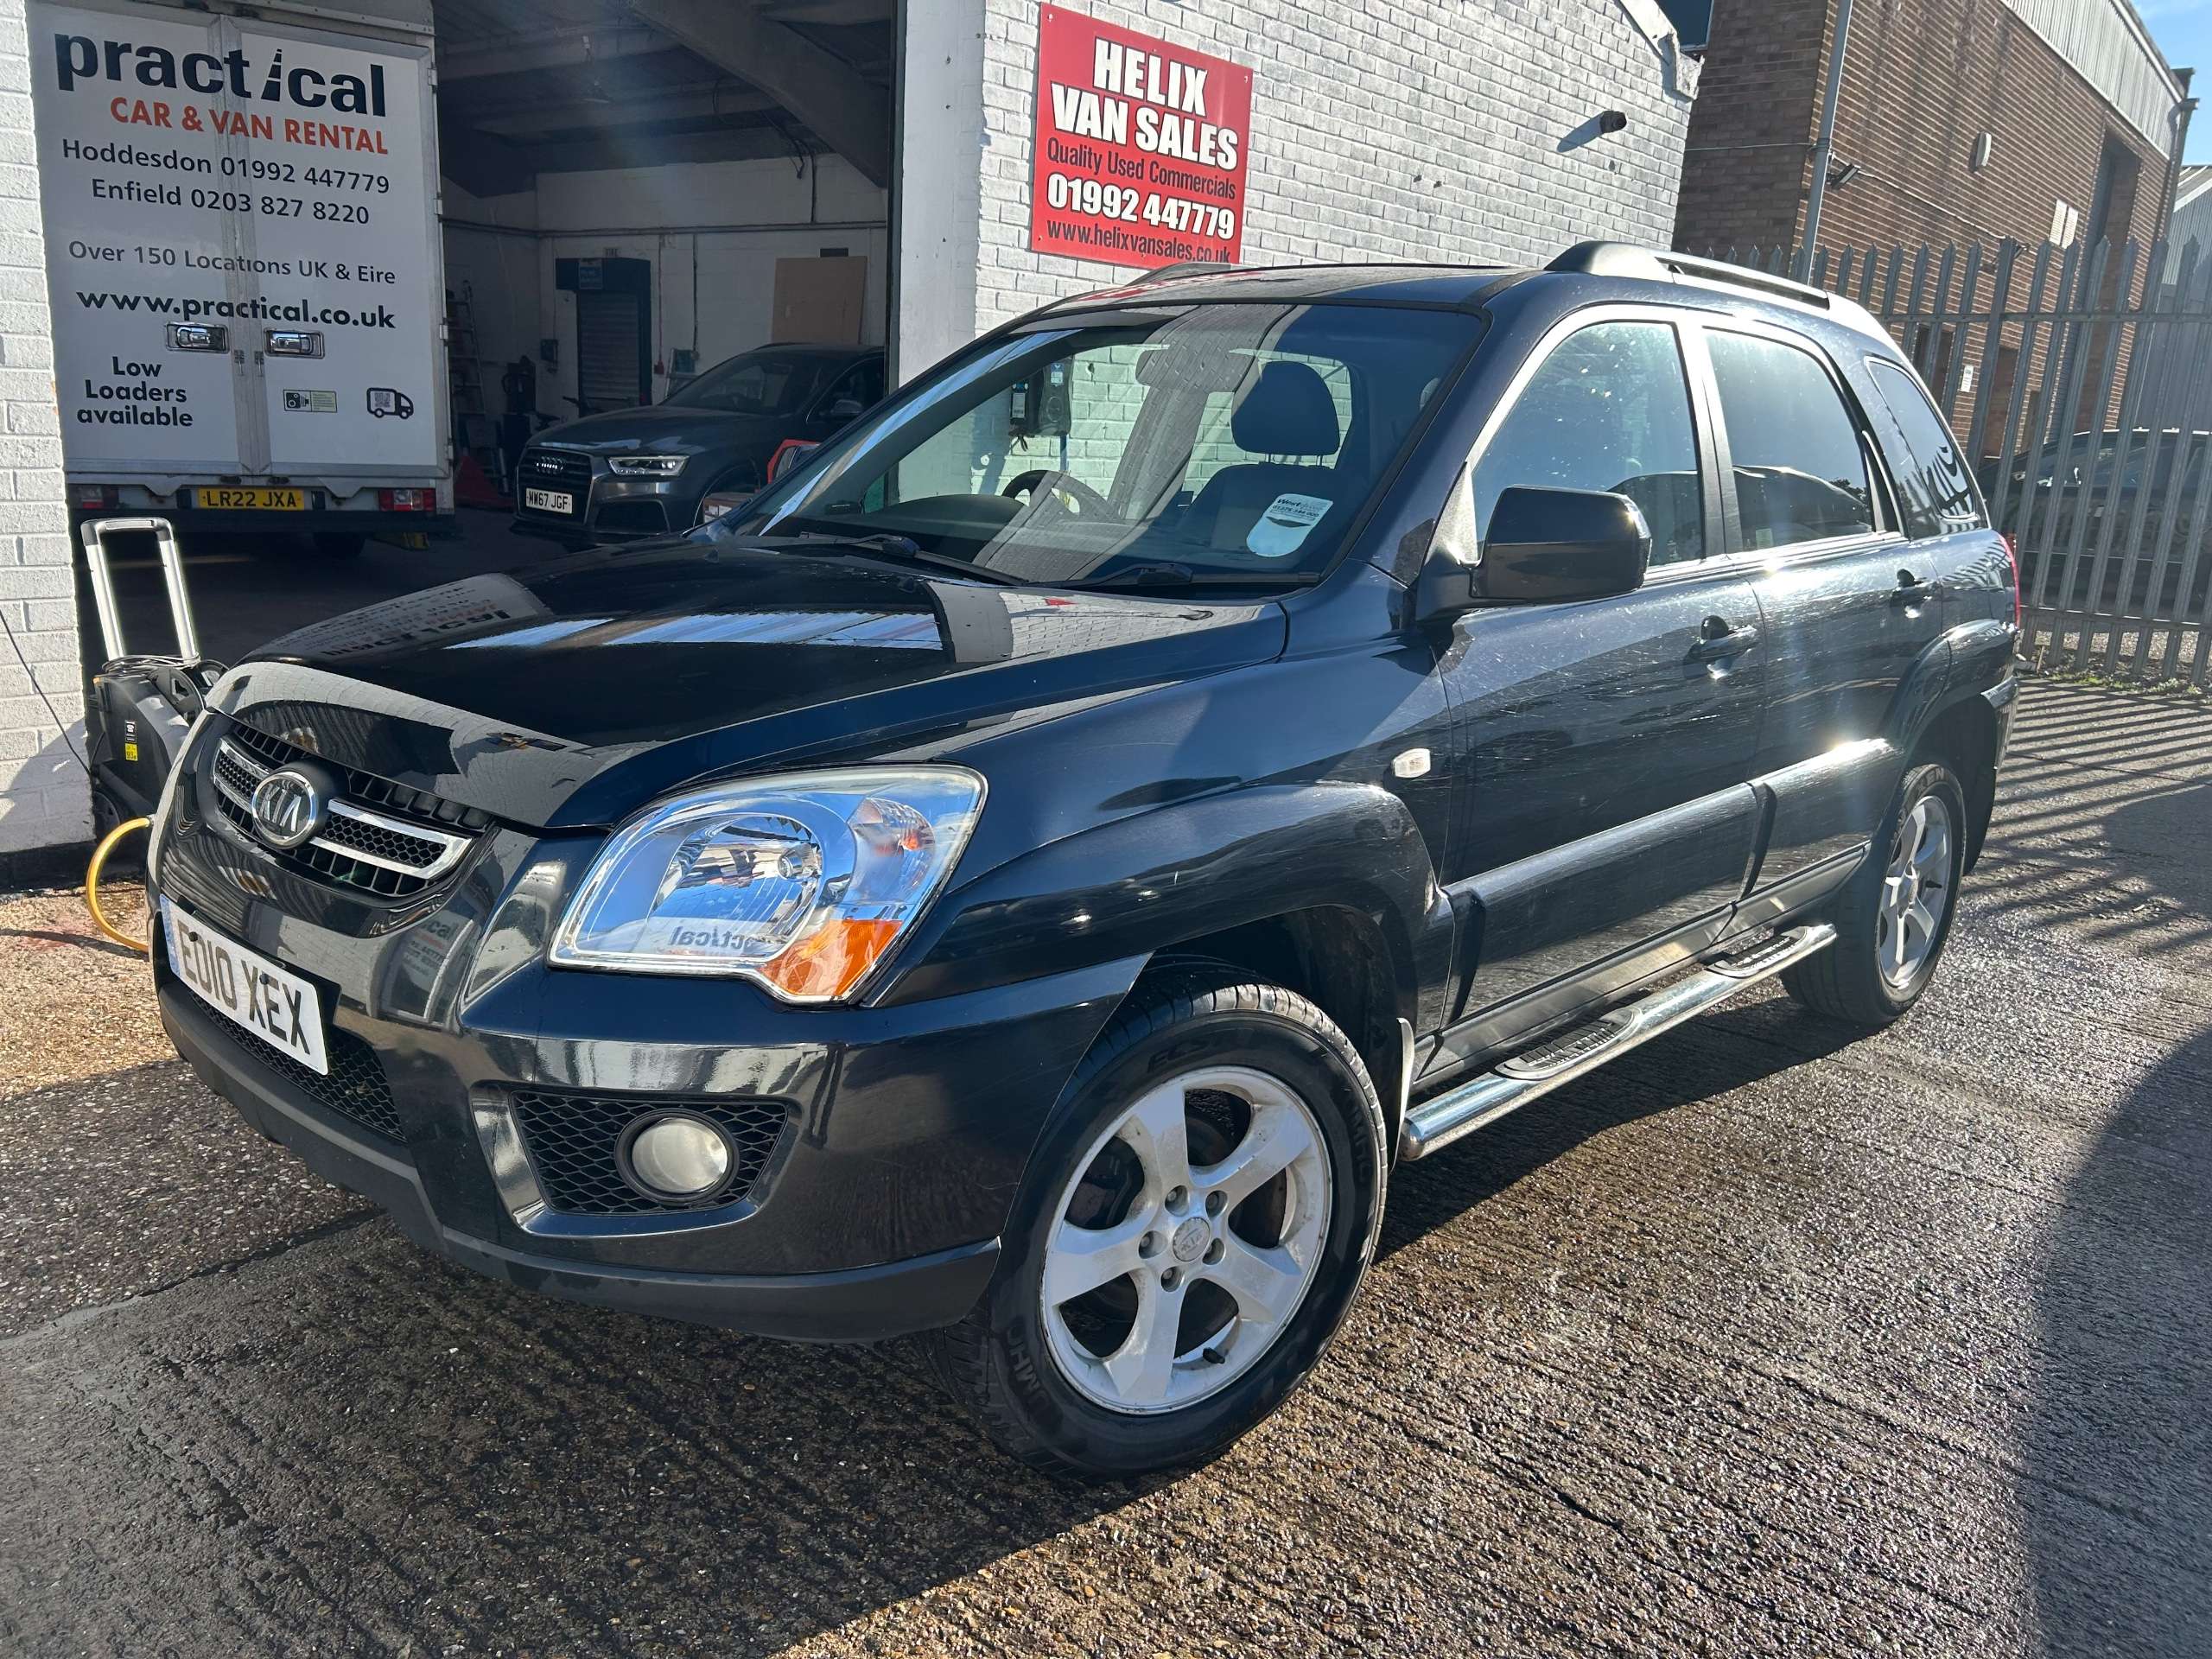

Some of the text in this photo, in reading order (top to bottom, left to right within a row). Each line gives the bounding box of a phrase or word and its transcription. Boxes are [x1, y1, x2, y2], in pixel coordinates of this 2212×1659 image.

[54, 32, 386, 118] practical
[1093, 37, 1208, 117] HELIX
[110, 97, 388, 155] CAR & VAN RENTAL
[1050, 81, 1239, 171] VAN SALES
[62, 138, 390, 194] Hoddesdon 01992 447779
[1047, 137, 1236, 200] Quality Used Commercials
[92, 178, 369, 225] Enfield 0203 827 8220
[1047, 173, 1235, 240] 01992 447779
[69, 240, 396, 284] Over 150 Locations UK & Eire
[1046, 219, 1230, 264] www.helixvansales.co.uk
[76, 290, 397, 329] www.practical.co.uk
[112, 356, 162, 378] Low
[85, 379, 187, 403] Loaders
[77, 405, 194, 428] available
[207, 490, 296, 507] LR22 JXA
[551, 494, 568, 510] JGF
[241, 958, 311, 1056] XEX
